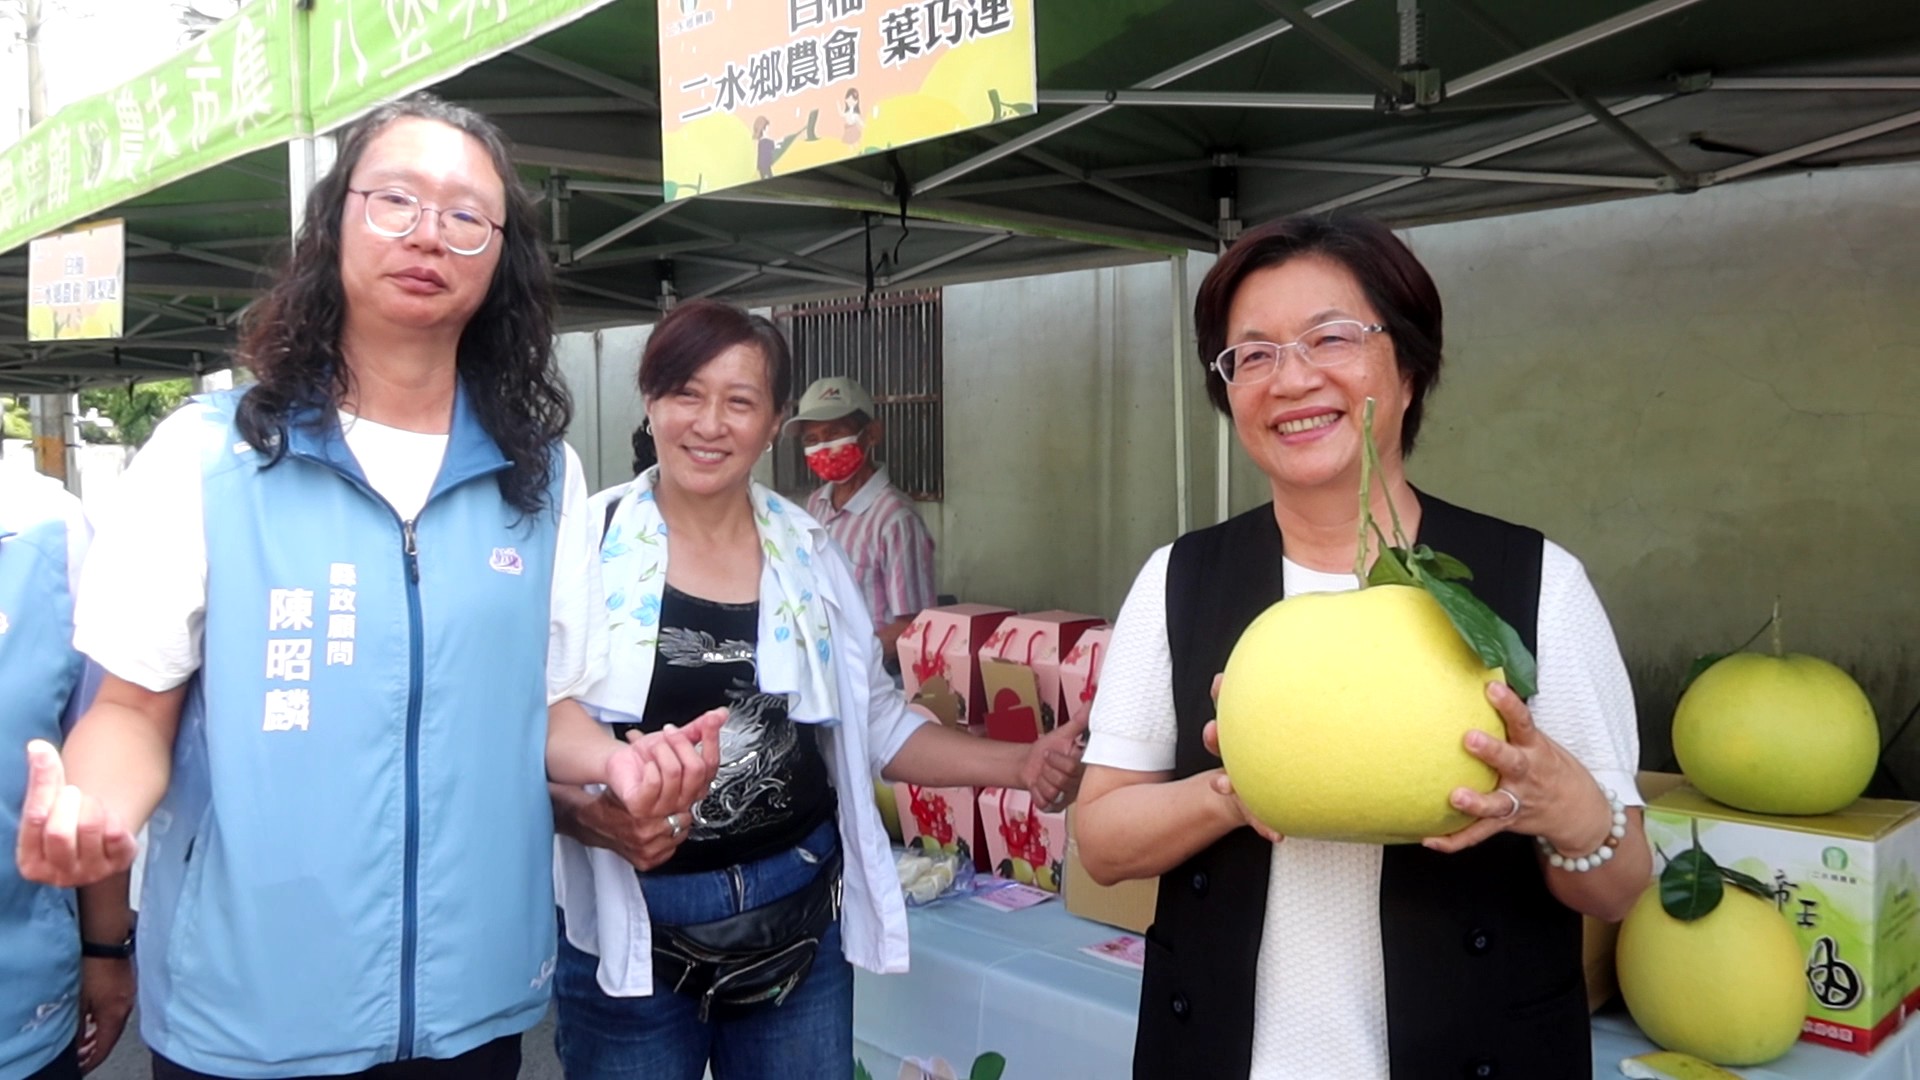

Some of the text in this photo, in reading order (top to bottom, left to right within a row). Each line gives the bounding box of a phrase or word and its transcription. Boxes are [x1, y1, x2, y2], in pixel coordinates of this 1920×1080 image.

[111, 14, 273, 180] 農夫市集
[681, 29, 858, 119] 二水鄉農會
[262, 588, 315, 733] 陳昭麟
[326, 562, 357, 667] 縣政顧問
